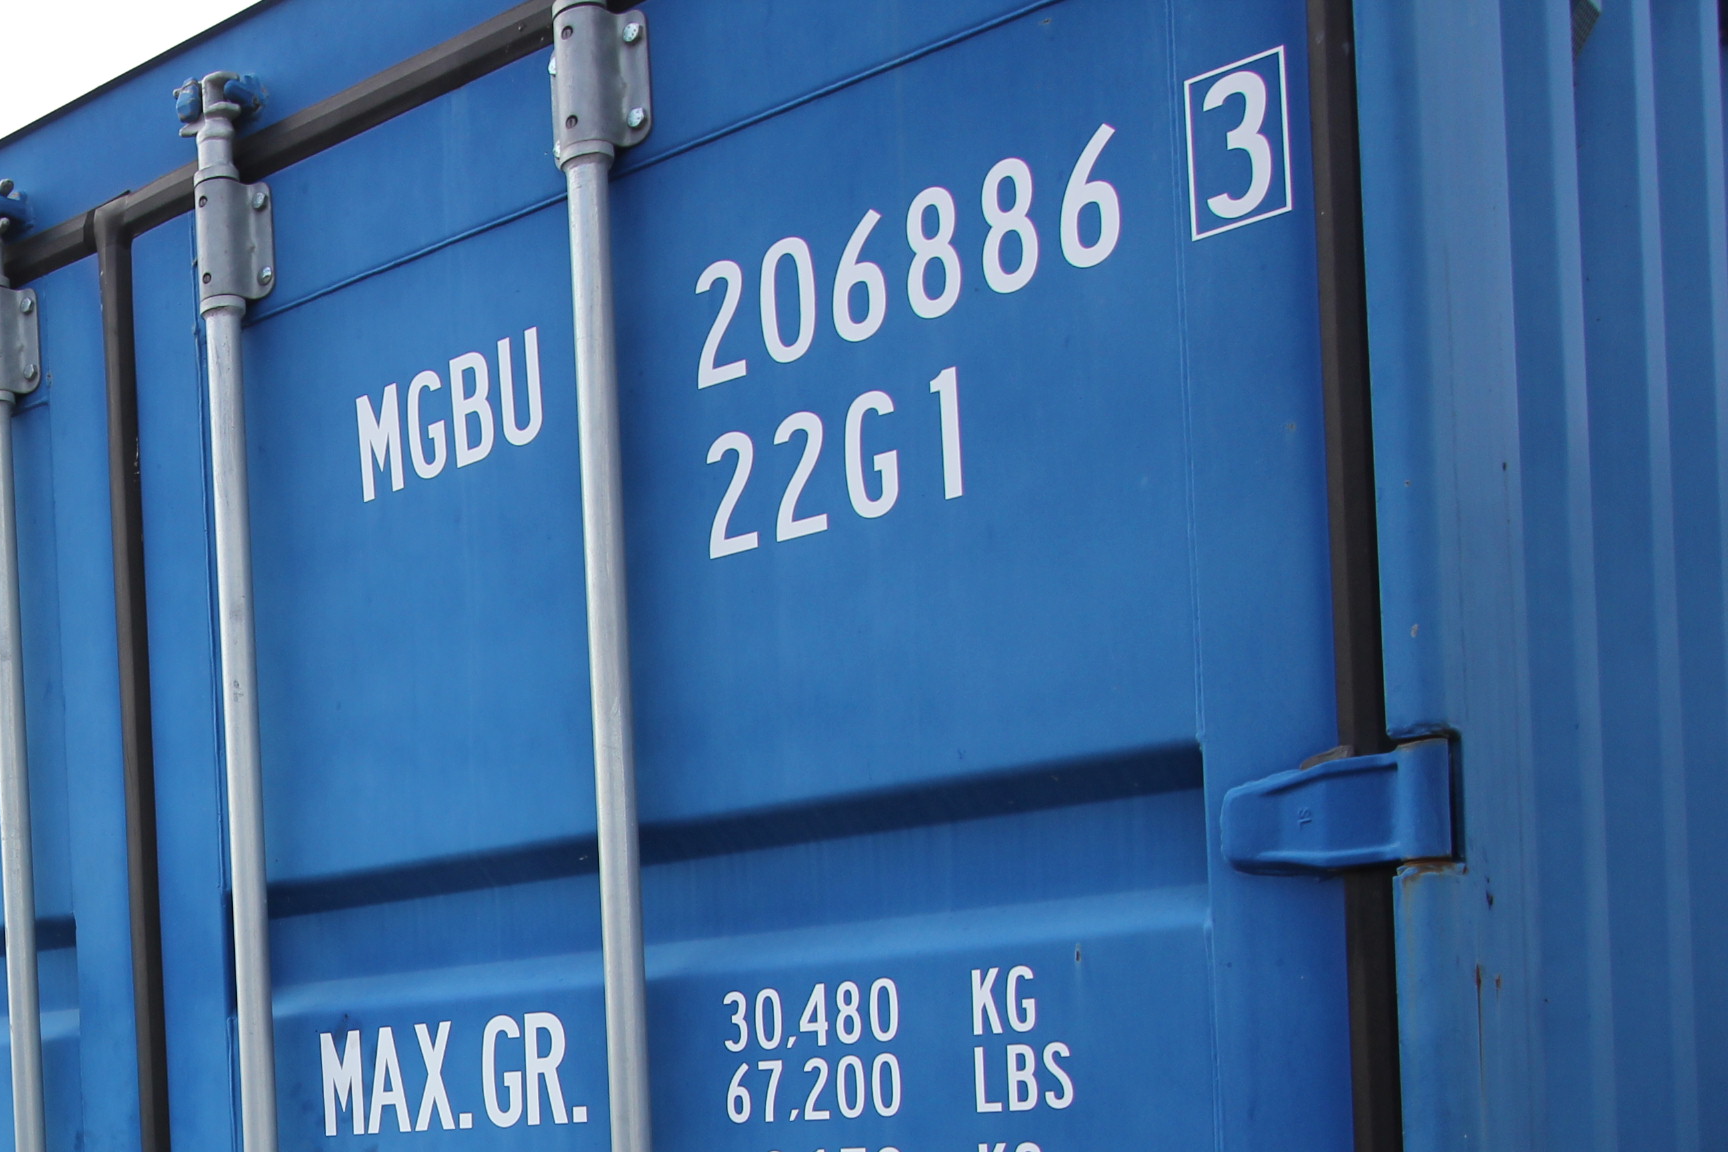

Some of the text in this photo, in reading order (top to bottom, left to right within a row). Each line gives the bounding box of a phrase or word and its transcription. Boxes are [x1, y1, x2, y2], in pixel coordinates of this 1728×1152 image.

[356, 70, 1275, 502] MGBU 206886 3
[707, 366, 963, 559] 22G1
[724, 966, 1035, 1051] 30,480 KG
[320, 1012, 587, 1136] MAX.GR.
[728, 1042, 1073, 1123] 67,200 LBS
